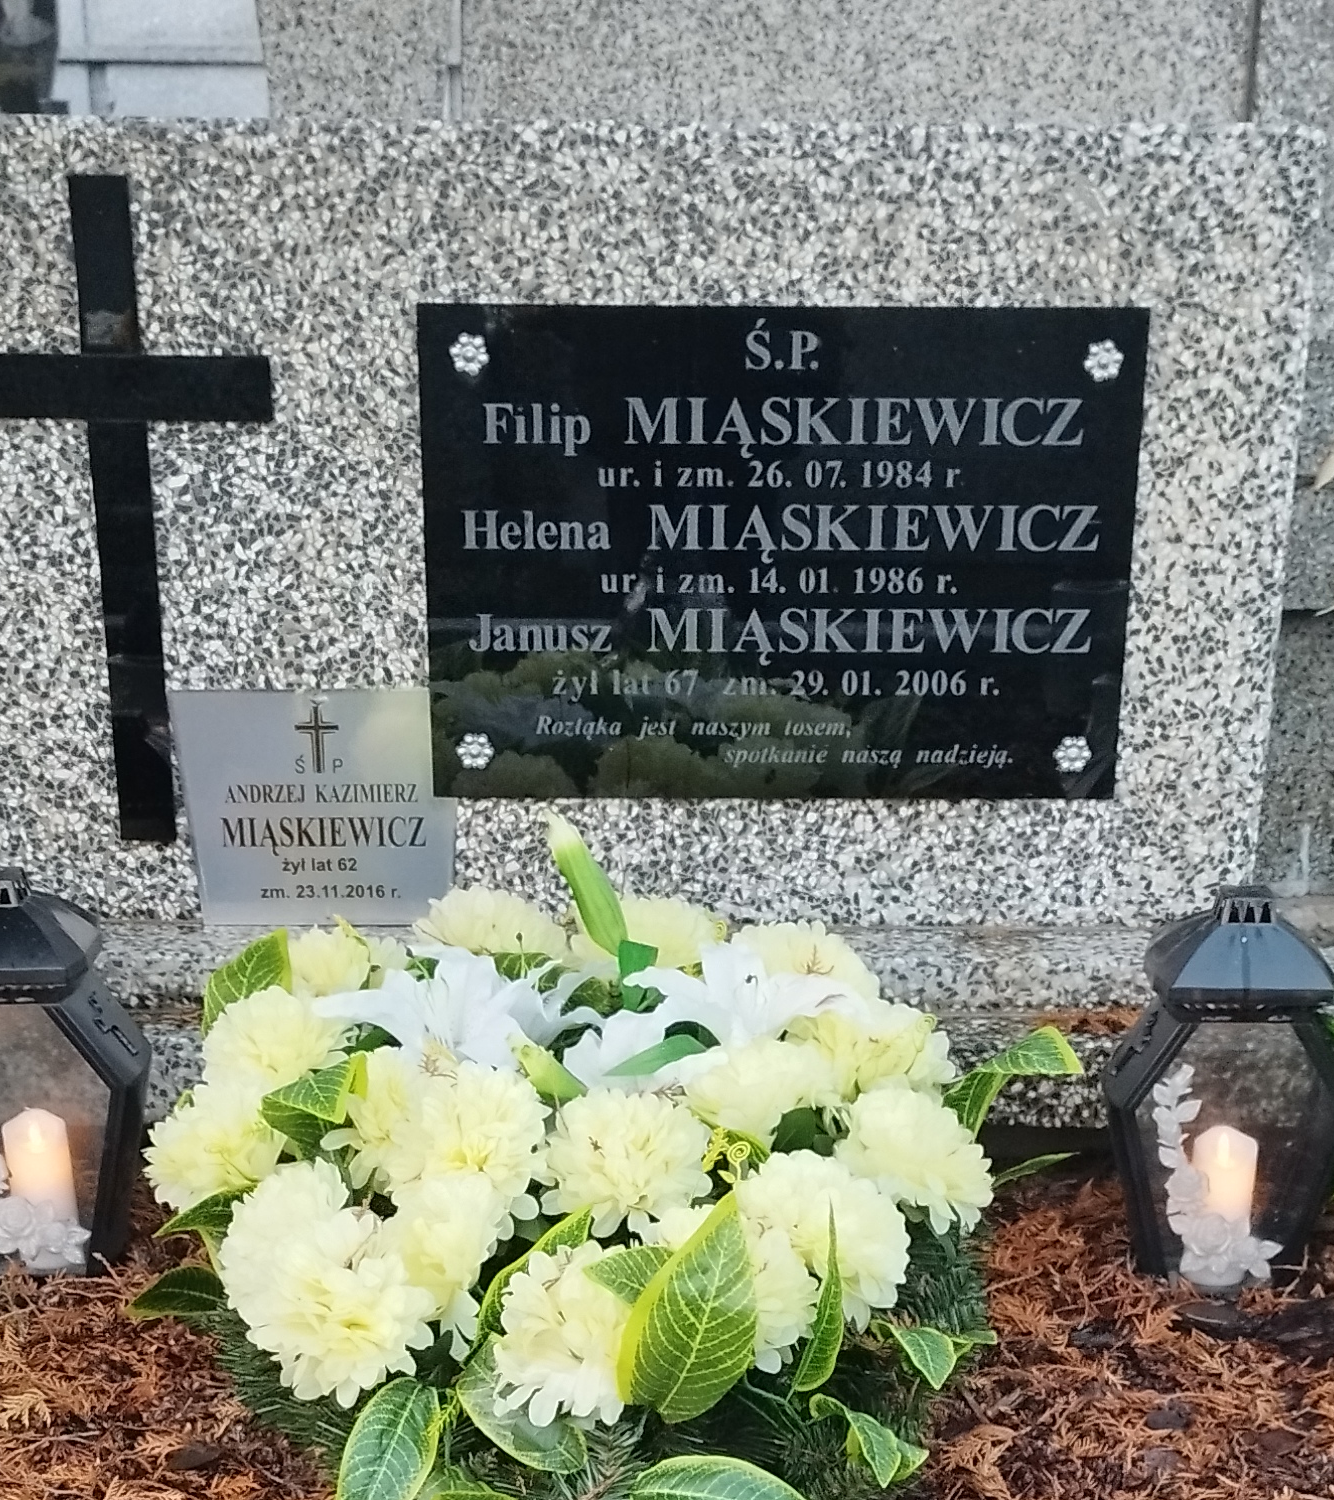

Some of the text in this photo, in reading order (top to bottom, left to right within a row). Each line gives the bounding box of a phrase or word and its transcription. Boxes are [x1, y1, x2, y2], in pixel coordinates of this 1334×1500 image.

[744, 318, 820, 371] Ś.P.
[482, 397, 1085, 459] Filip MIĄSKIEWICZ
[597, 466, 641, 488] ur.
[654, 460, 664, 488] i
[676, 466, 735, 488] zm.
[747, 460, 793, 489] 26.
[804, 460, 847, 489] 07.
[861, 460, 933, 488] 1984
[461, 504, 1101, 564] Helena MIĄSKIEWICZ
[656, 566, 665, 594] i
[677, 572, 736, 594] zm.
[748, 567, 787, 594] 14.
[853, 567, 925, 594] 1986
[936, 573, 959, 594] r.
[468, 607, 1093, 666] Janusz MIĄSKIEWICZ
[552, 669, 1001, 702] żył lat 67 zm. 29. 01. 2006 r.
[635, 715, 677, 742] jest
[690, 721, 772, 742] naszym
[295, 755, 344, 775] Ś P
[723, 744, 1014, 770] spotkanie naszą nadzieją.
[224, 783, 419, 804] ANDRZEJ KAZIMIERZ
[220, 816, 428, 857] MIĄSKIEWICZ
[281, 857, 359, 875] żył lat 62
[260, 884, 403, 900] zm. 23.11.2016 r.
